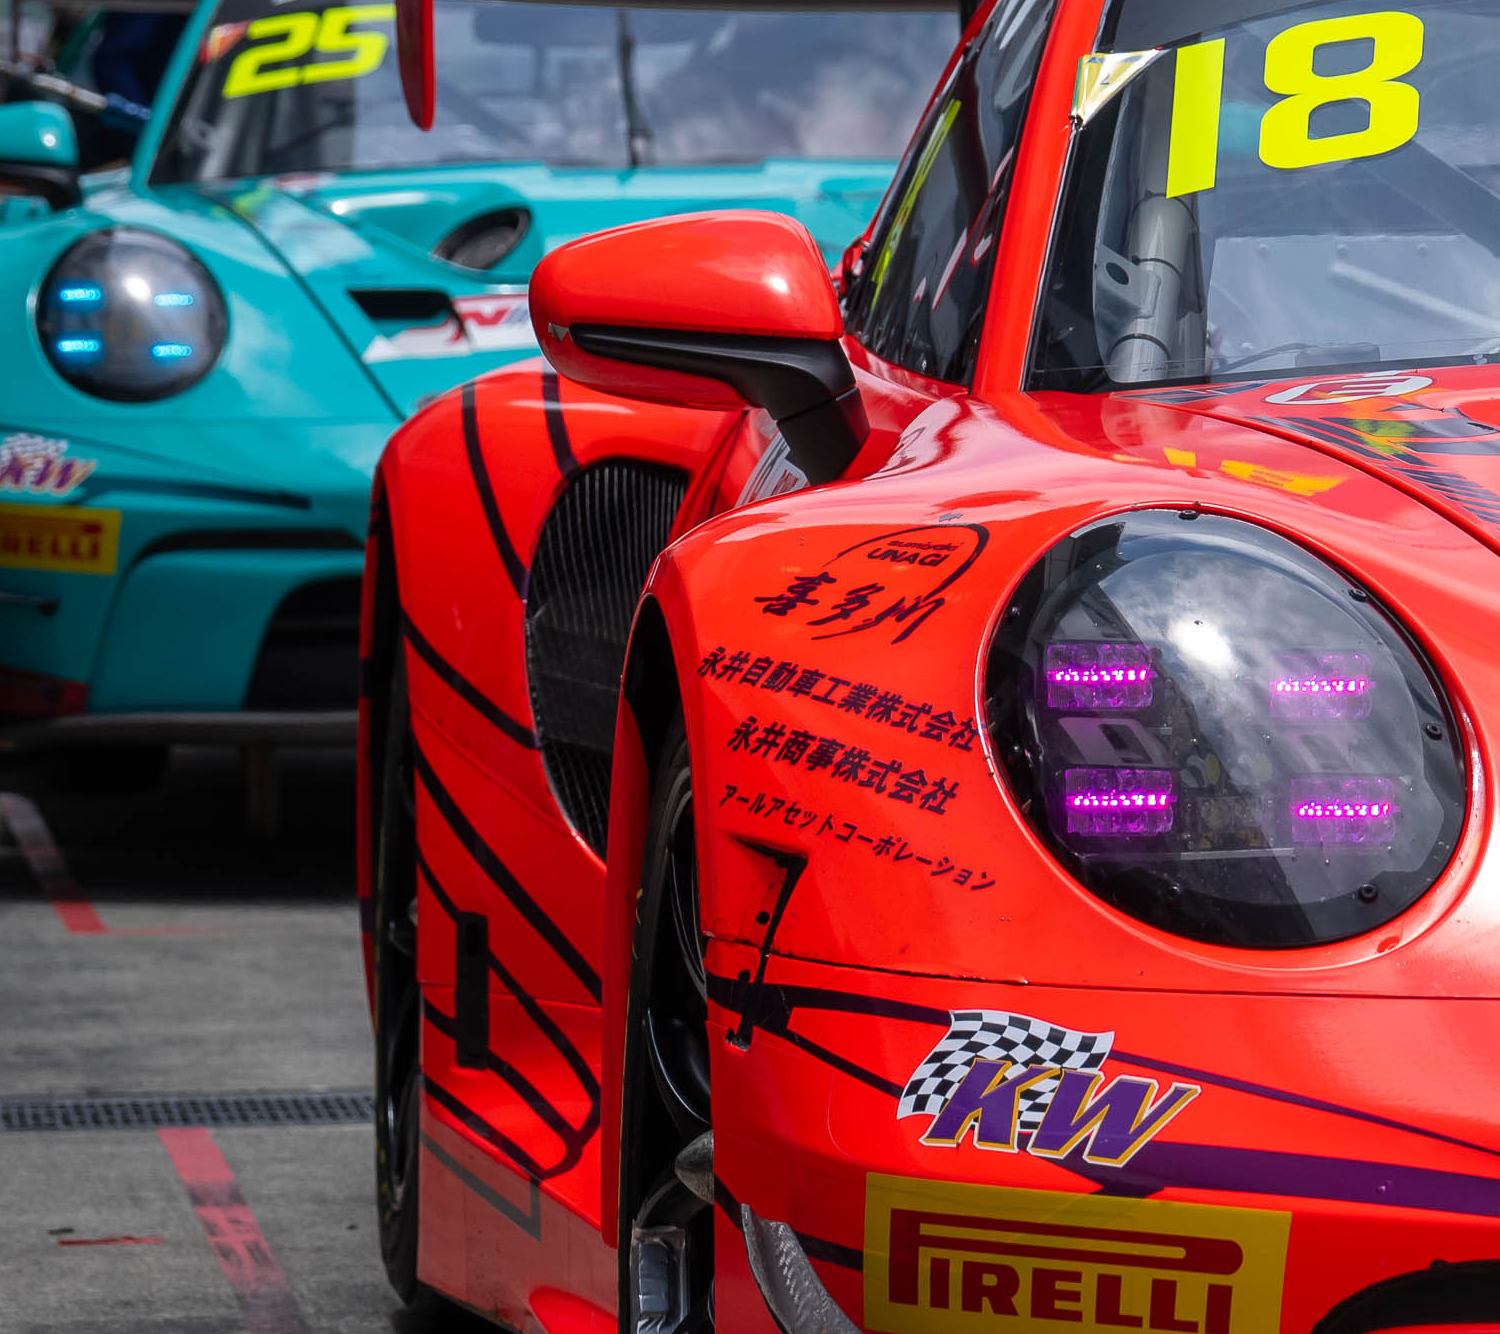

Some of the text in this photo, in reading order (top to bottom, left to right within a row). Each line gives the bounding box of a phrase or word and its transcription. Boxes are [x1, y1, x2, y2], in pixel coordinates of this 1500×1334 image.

[221, 2, 397, 101] 25
[1165, 10, 1426, 200] 18
[866, 547, 951, 568] UNAGI
[699, 646, 981, 753] 永井自動車工業株式会社
[726, 715, 961, 816] 永井商事株式会社
[718, 783, 996, 893] アールアセットコーポレーション
[917, 1056, 1203, 1168] KW
